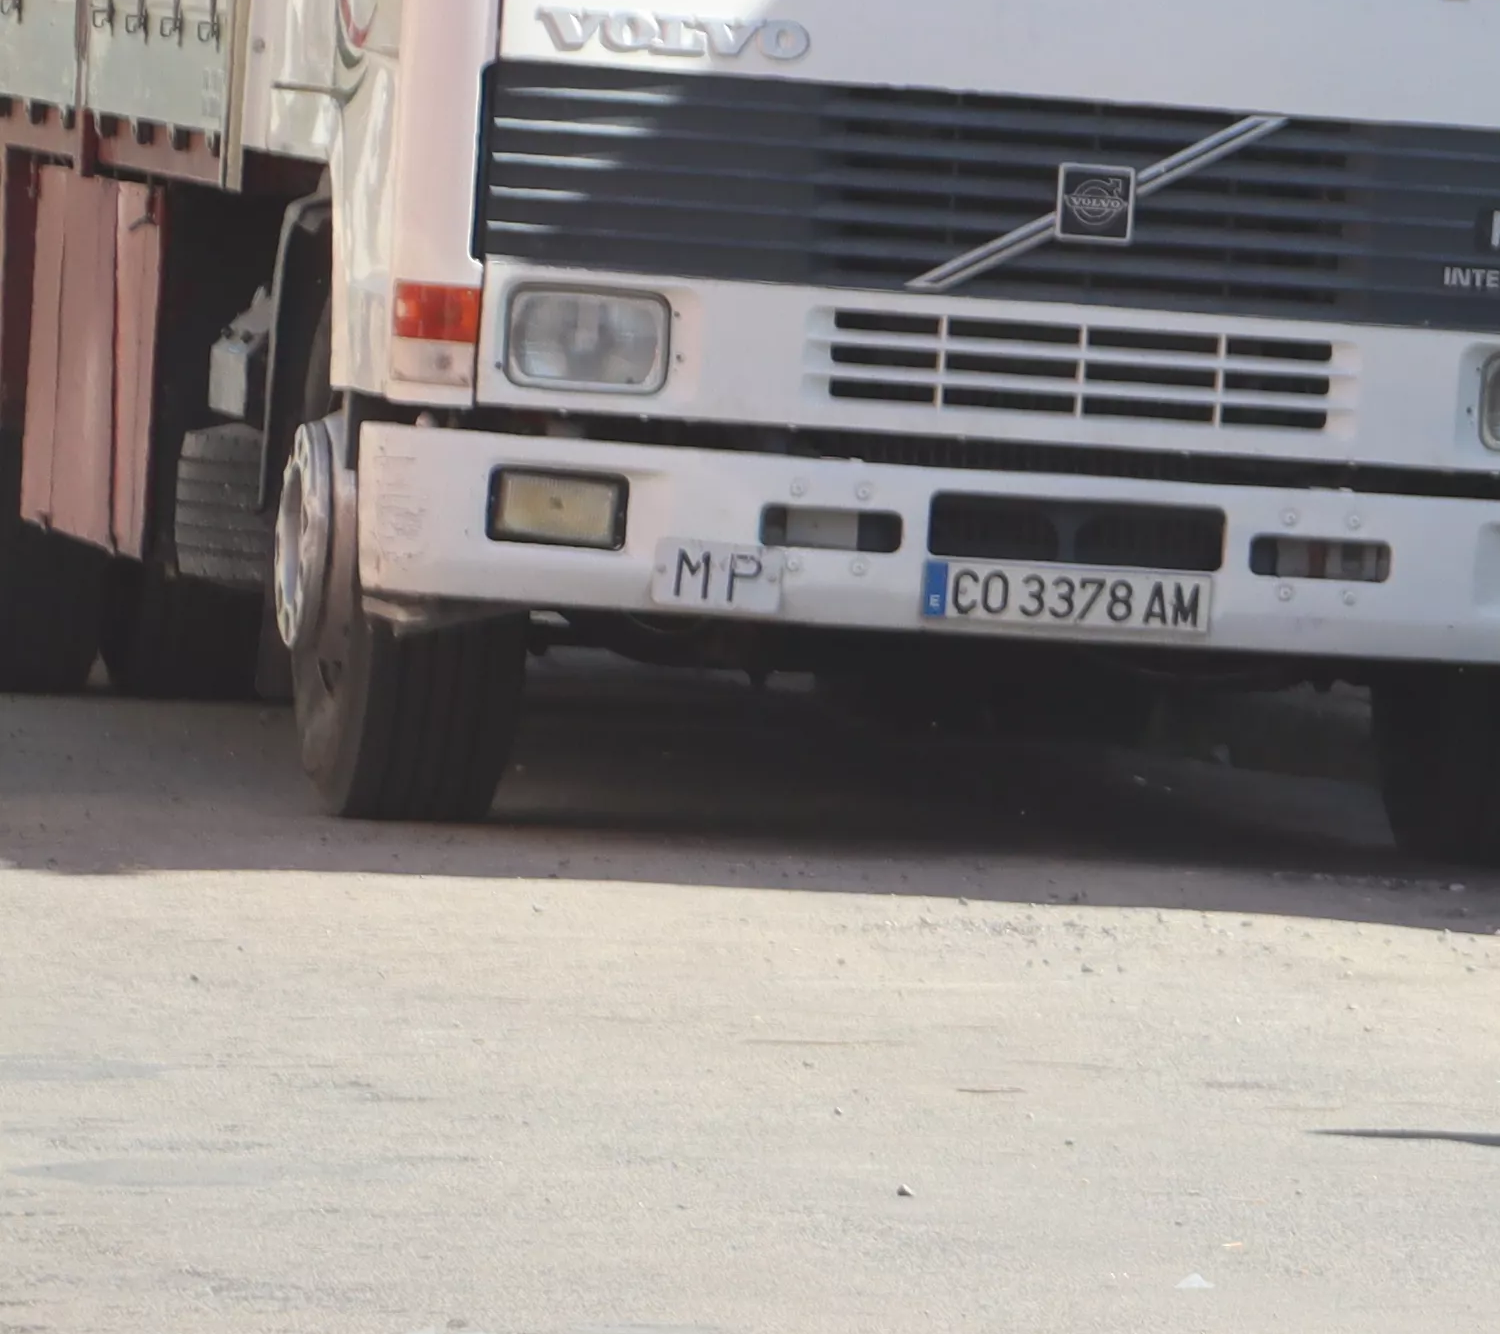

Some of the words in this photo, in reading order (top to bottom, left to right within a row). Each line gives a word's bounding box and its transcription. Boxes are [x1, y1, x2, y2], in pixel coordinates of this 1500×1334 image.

[534, 5, 811, 61] VOLVO
[1070, 196, 1121, 208] VOLVO
[951, 568, 1010, 615] CO
[1018, 573, 1133, 623] 3378
[1141, 581, 1201, 628] AM
